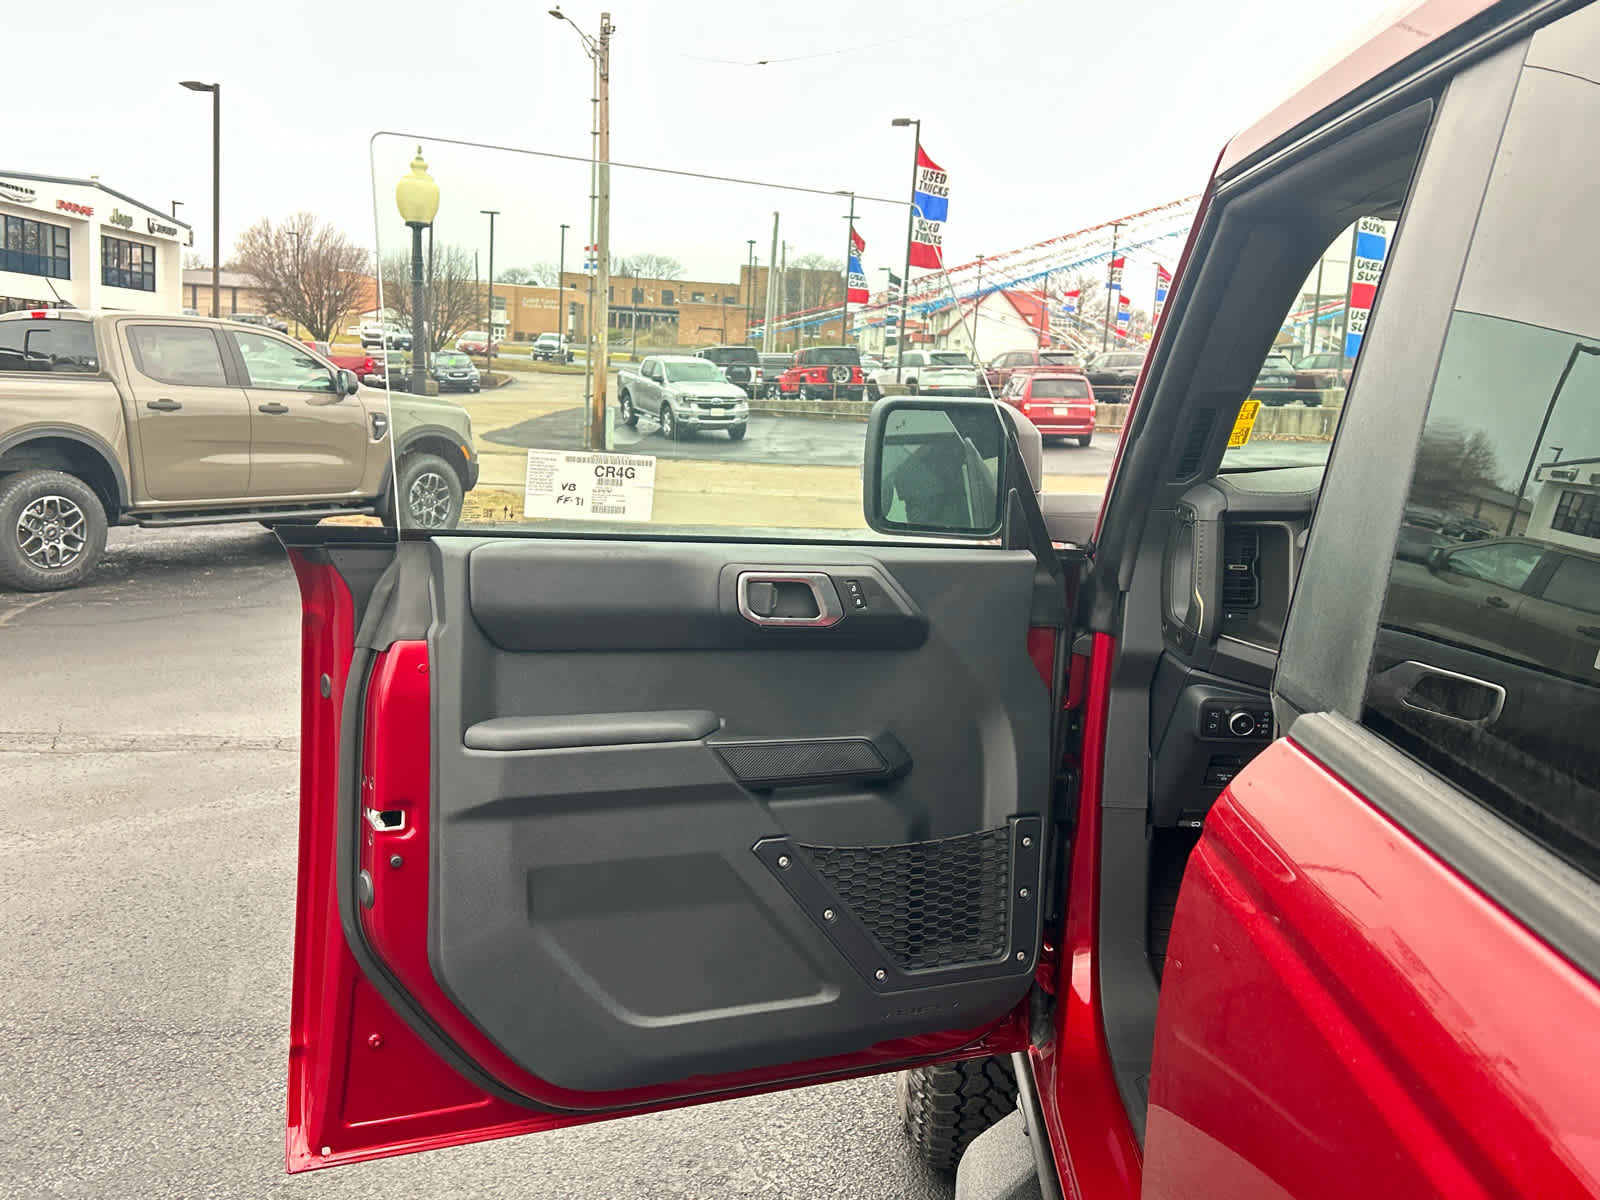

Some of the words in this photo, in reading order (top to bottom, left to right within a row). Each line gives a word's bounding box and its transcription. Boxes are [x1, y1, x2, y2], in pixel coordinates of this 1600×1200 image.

[922, 169, 948, 184] USED
[918, 180, 950, 197] TRUCKS
[56, 200, 95, 217] DODGE
[109, 208, 133, 229] Jeep
[1356, 271, 1379, 282] SUV
[594, 465, 636, 480] CR4G
